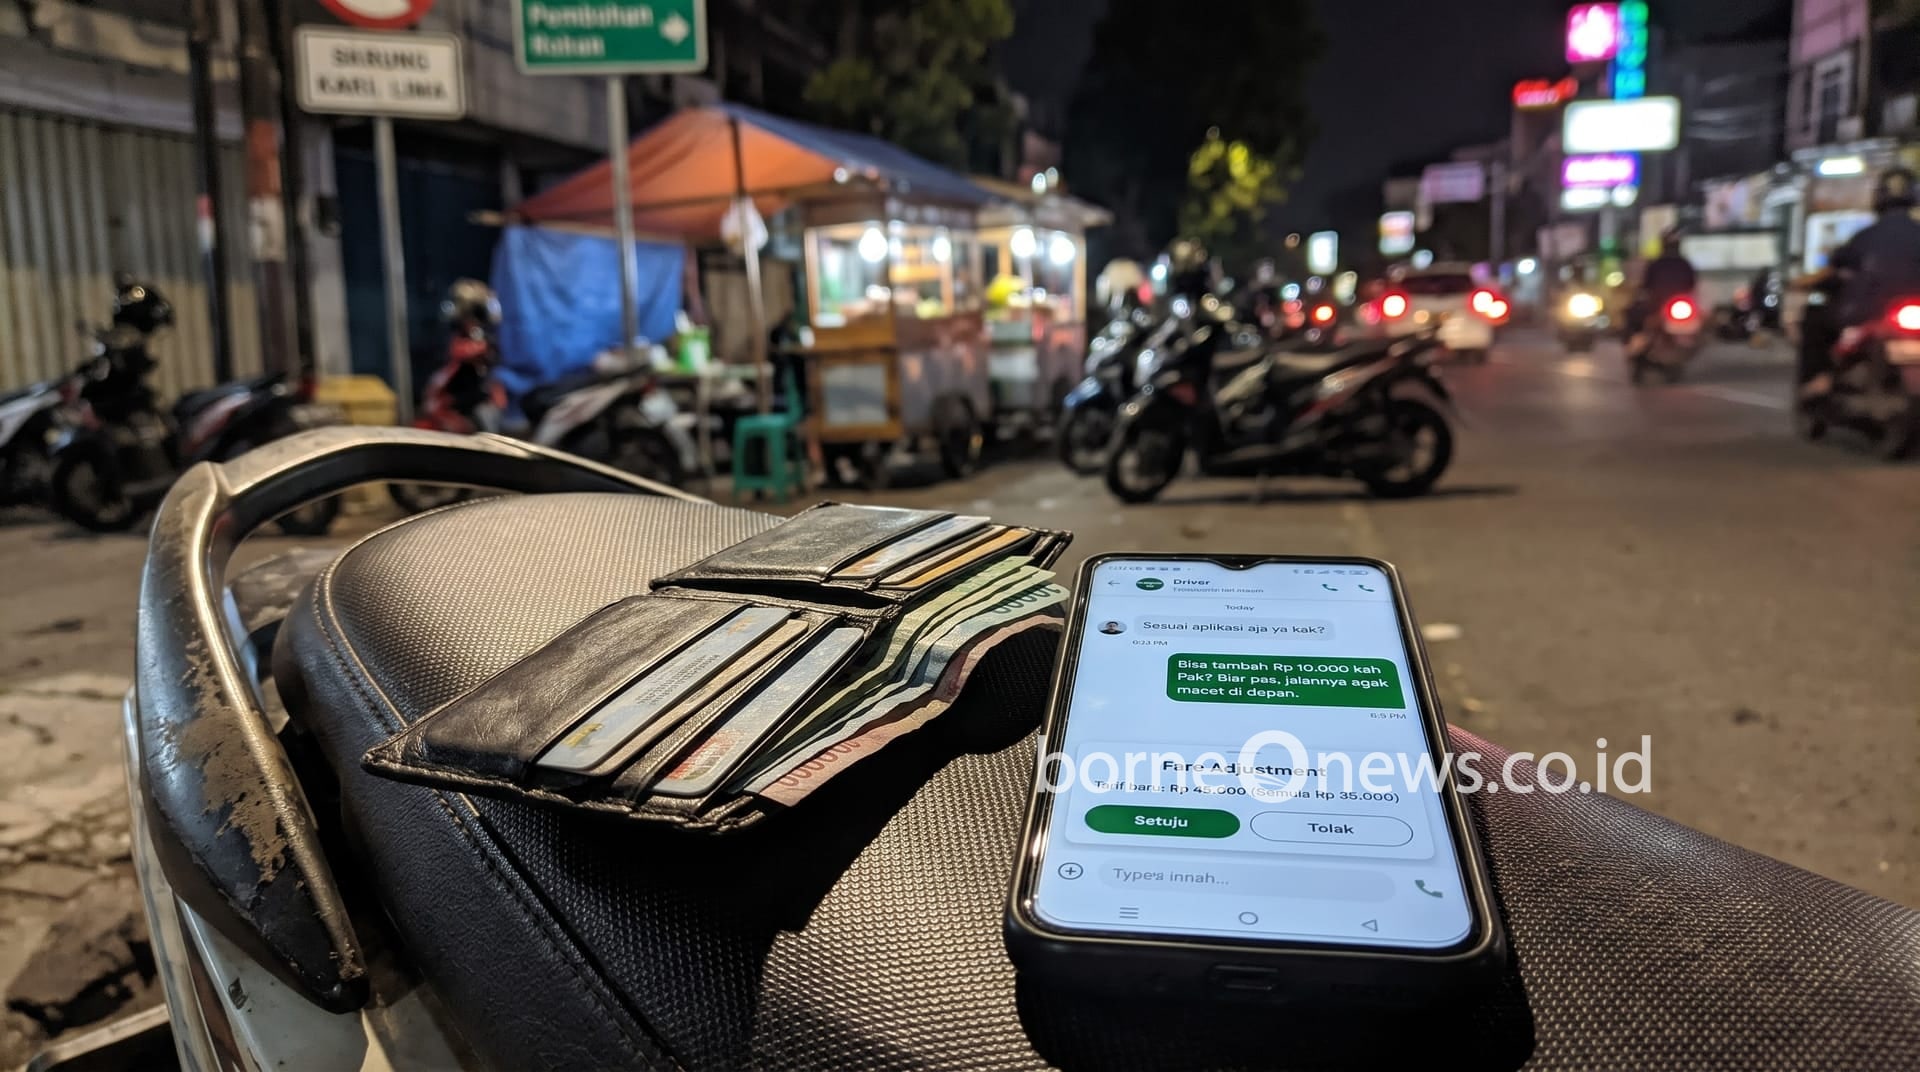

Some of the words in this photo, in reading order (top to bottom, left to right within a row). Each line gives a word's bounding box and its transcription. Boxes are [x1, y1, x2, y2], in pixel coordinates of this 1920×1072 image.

[1173, 578, 1211, 586] Driver
[1225, 604, 1255, 612] Today
[1143, 621, 1188, 631] Sesuai
[1192, 622, 1244, 633] aplikasi
[1247, 625, 1268, 634] aja
[1271, 626, 1288, 634] ya
[1292, 626, 1326, 635] kak?
[1178, 660, 1208, 669] Bisa
[1212, 661, 1269, 671] tambah
[1273, 663, 1293, 673] Rp
[1297, 664, 1349, 673] 10.000
[1353, 665, 1381, 674] kah
[1177, 672, 1213, 682] Pak?
[1217, 673, 1246, 683] Biar
[1285, 675, 1347, 687] jalannya
[1351, 678, 1389, 689] agak
[1177, 686, 1225, 696] macet
[1228, 687, 1242, 696] di
[1246, 688, 1300, 699] depan.
[1163, 760, 1205, 772] Fare
[1211, 762, 1326, 777] Adjustment
[1094, 780, 1126, 791] Tarif
[1170, 784, 1189, 795] Rp
[1193, 785, 1246, 796] 45.000
[1251, 786, 1311, 798] (Semula
[1315, 790, 1335, 801] Rp
[1339, 791, 1400, 803] 35.000)
[1134, 815, 1188, 828] Setuju
[1308, 822, 1354, 834] Tolak
